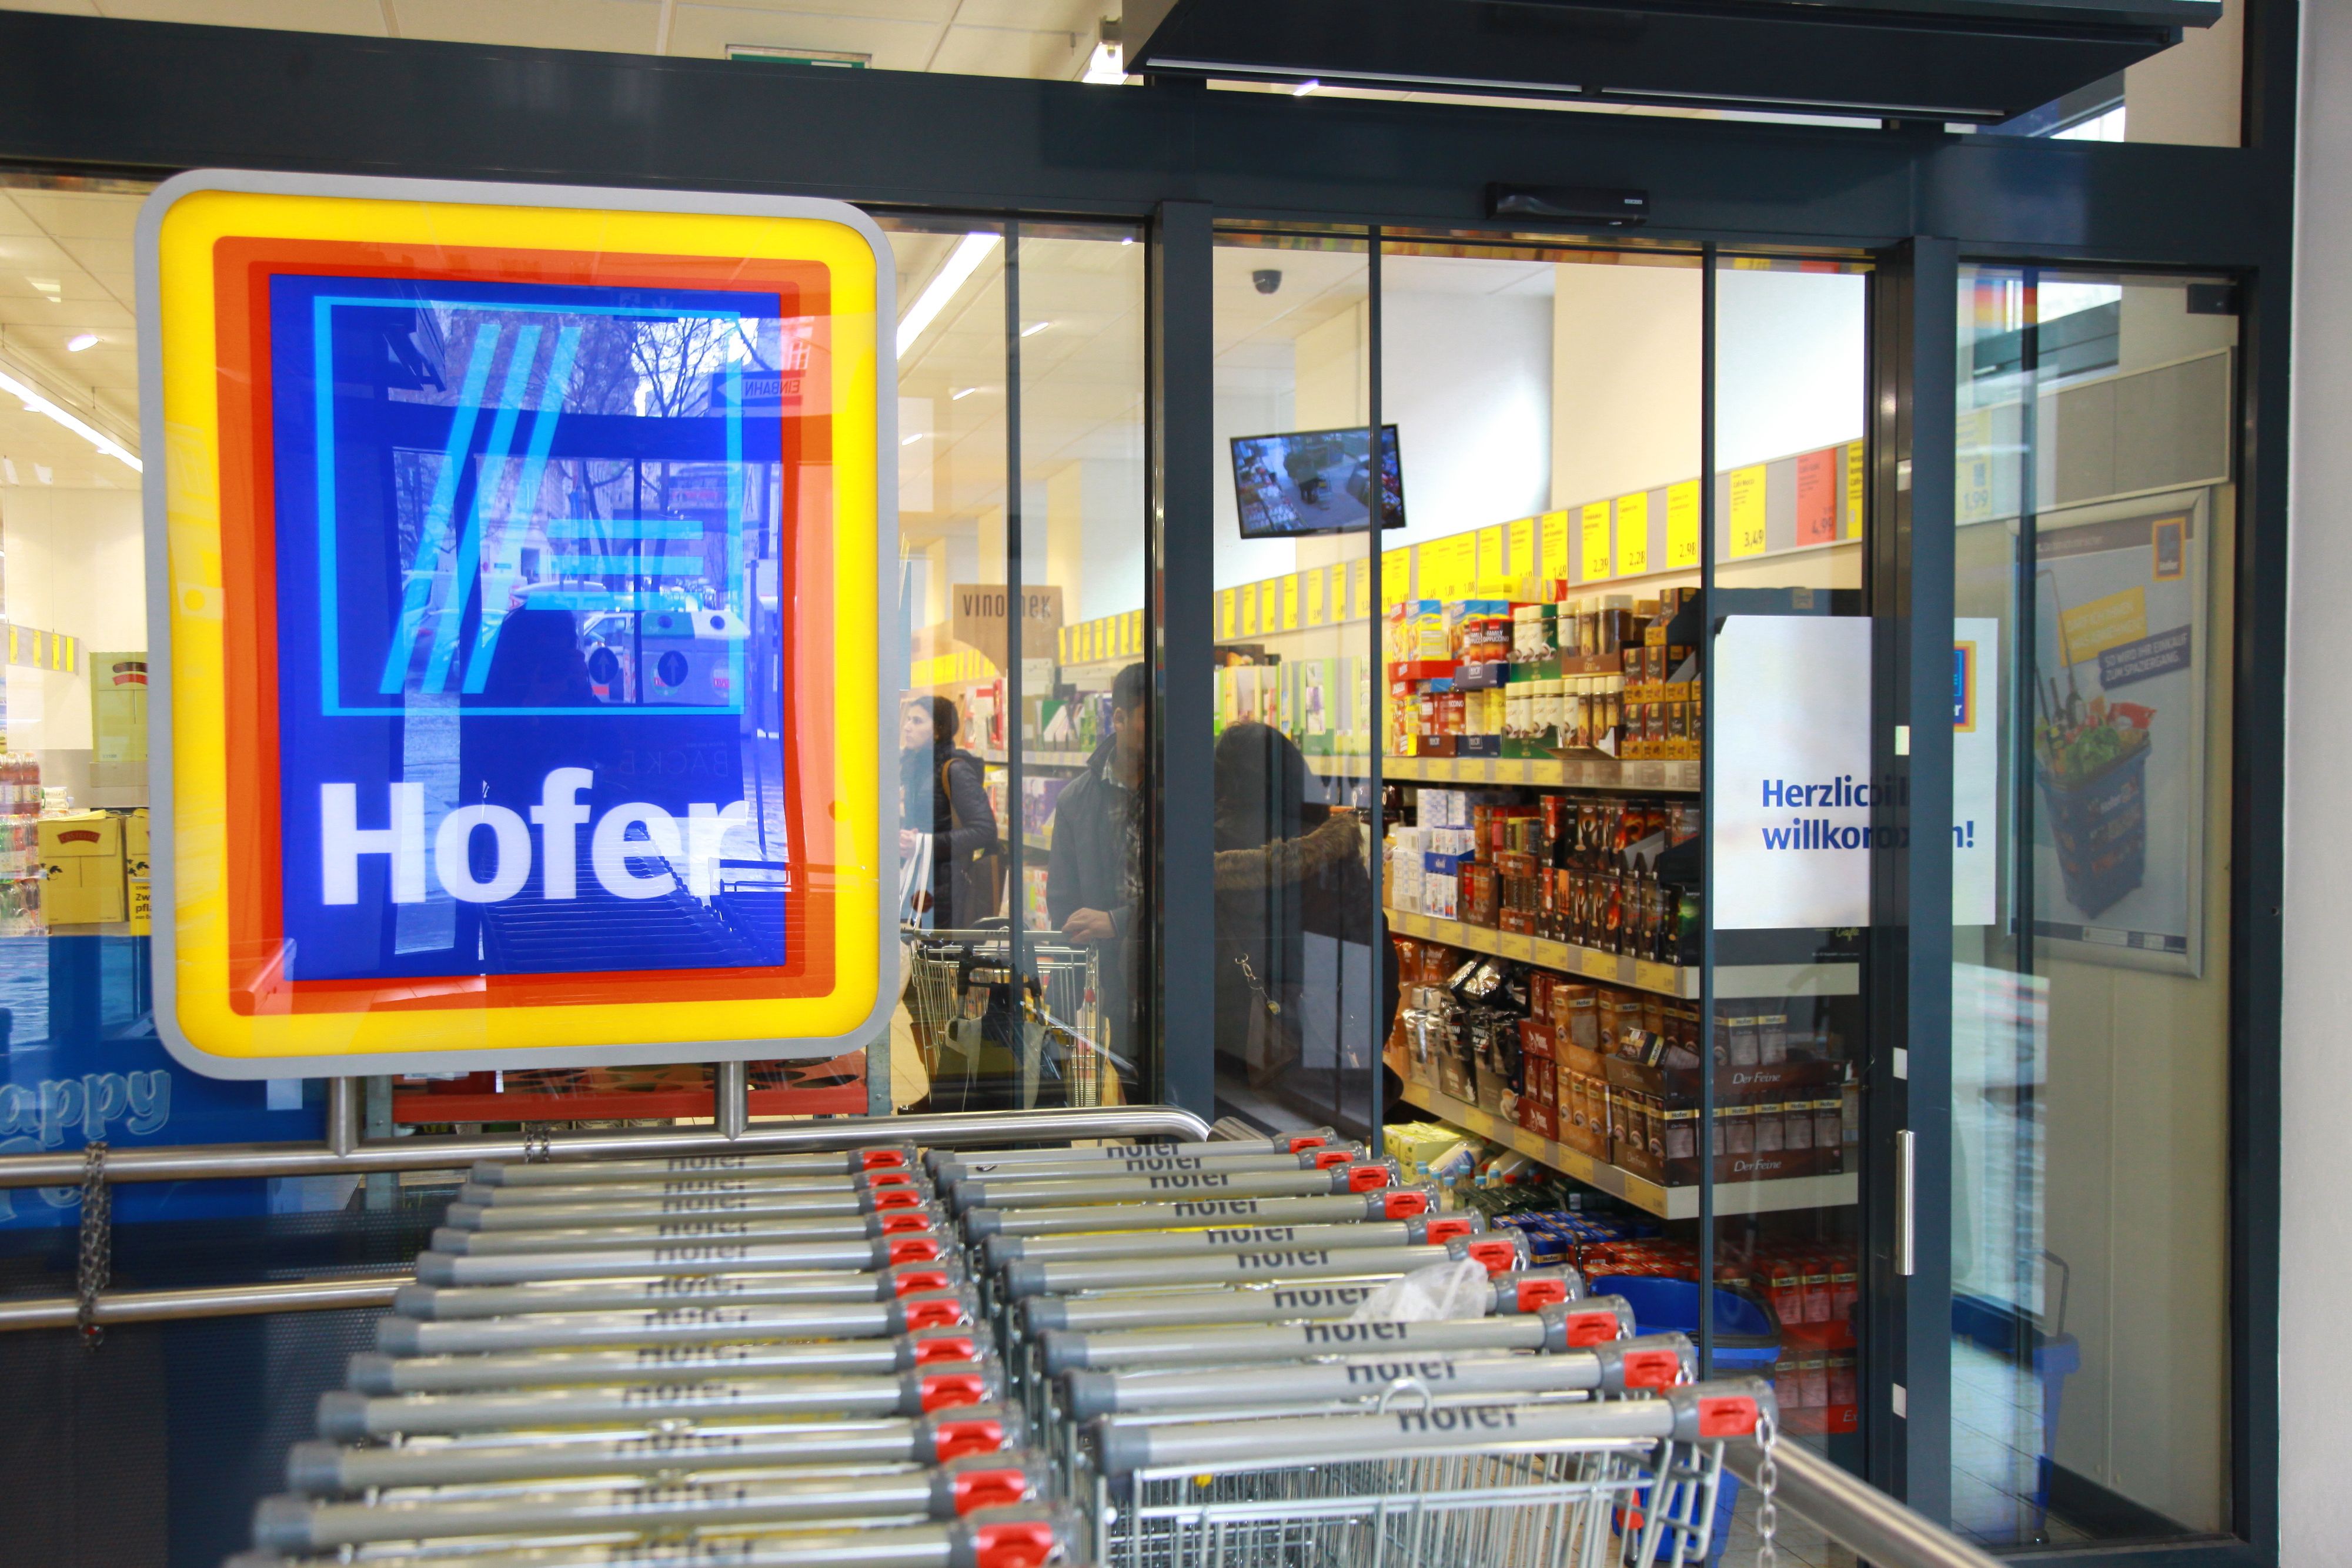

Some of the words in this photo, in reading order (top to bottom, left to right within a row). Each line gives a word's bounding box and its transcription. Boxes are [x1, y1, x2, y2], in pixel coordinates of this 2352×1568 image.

[1744, 529, 1765, 548] 3,49
[1763, 774, 1869, 808] Herzlic
[319, 767, 750, 905] Hofer
[1762, 817, 1975, 850] willkon!
[1733, 1072, 1752, 1084] Der
[1754, 1071, 1781, 1083] Feine
[1734, 1161, 1754, 1172] Der
[1755, 1160, 1782, 1171] Feine
[1779, 1278, 1796, 1286] Hofer
